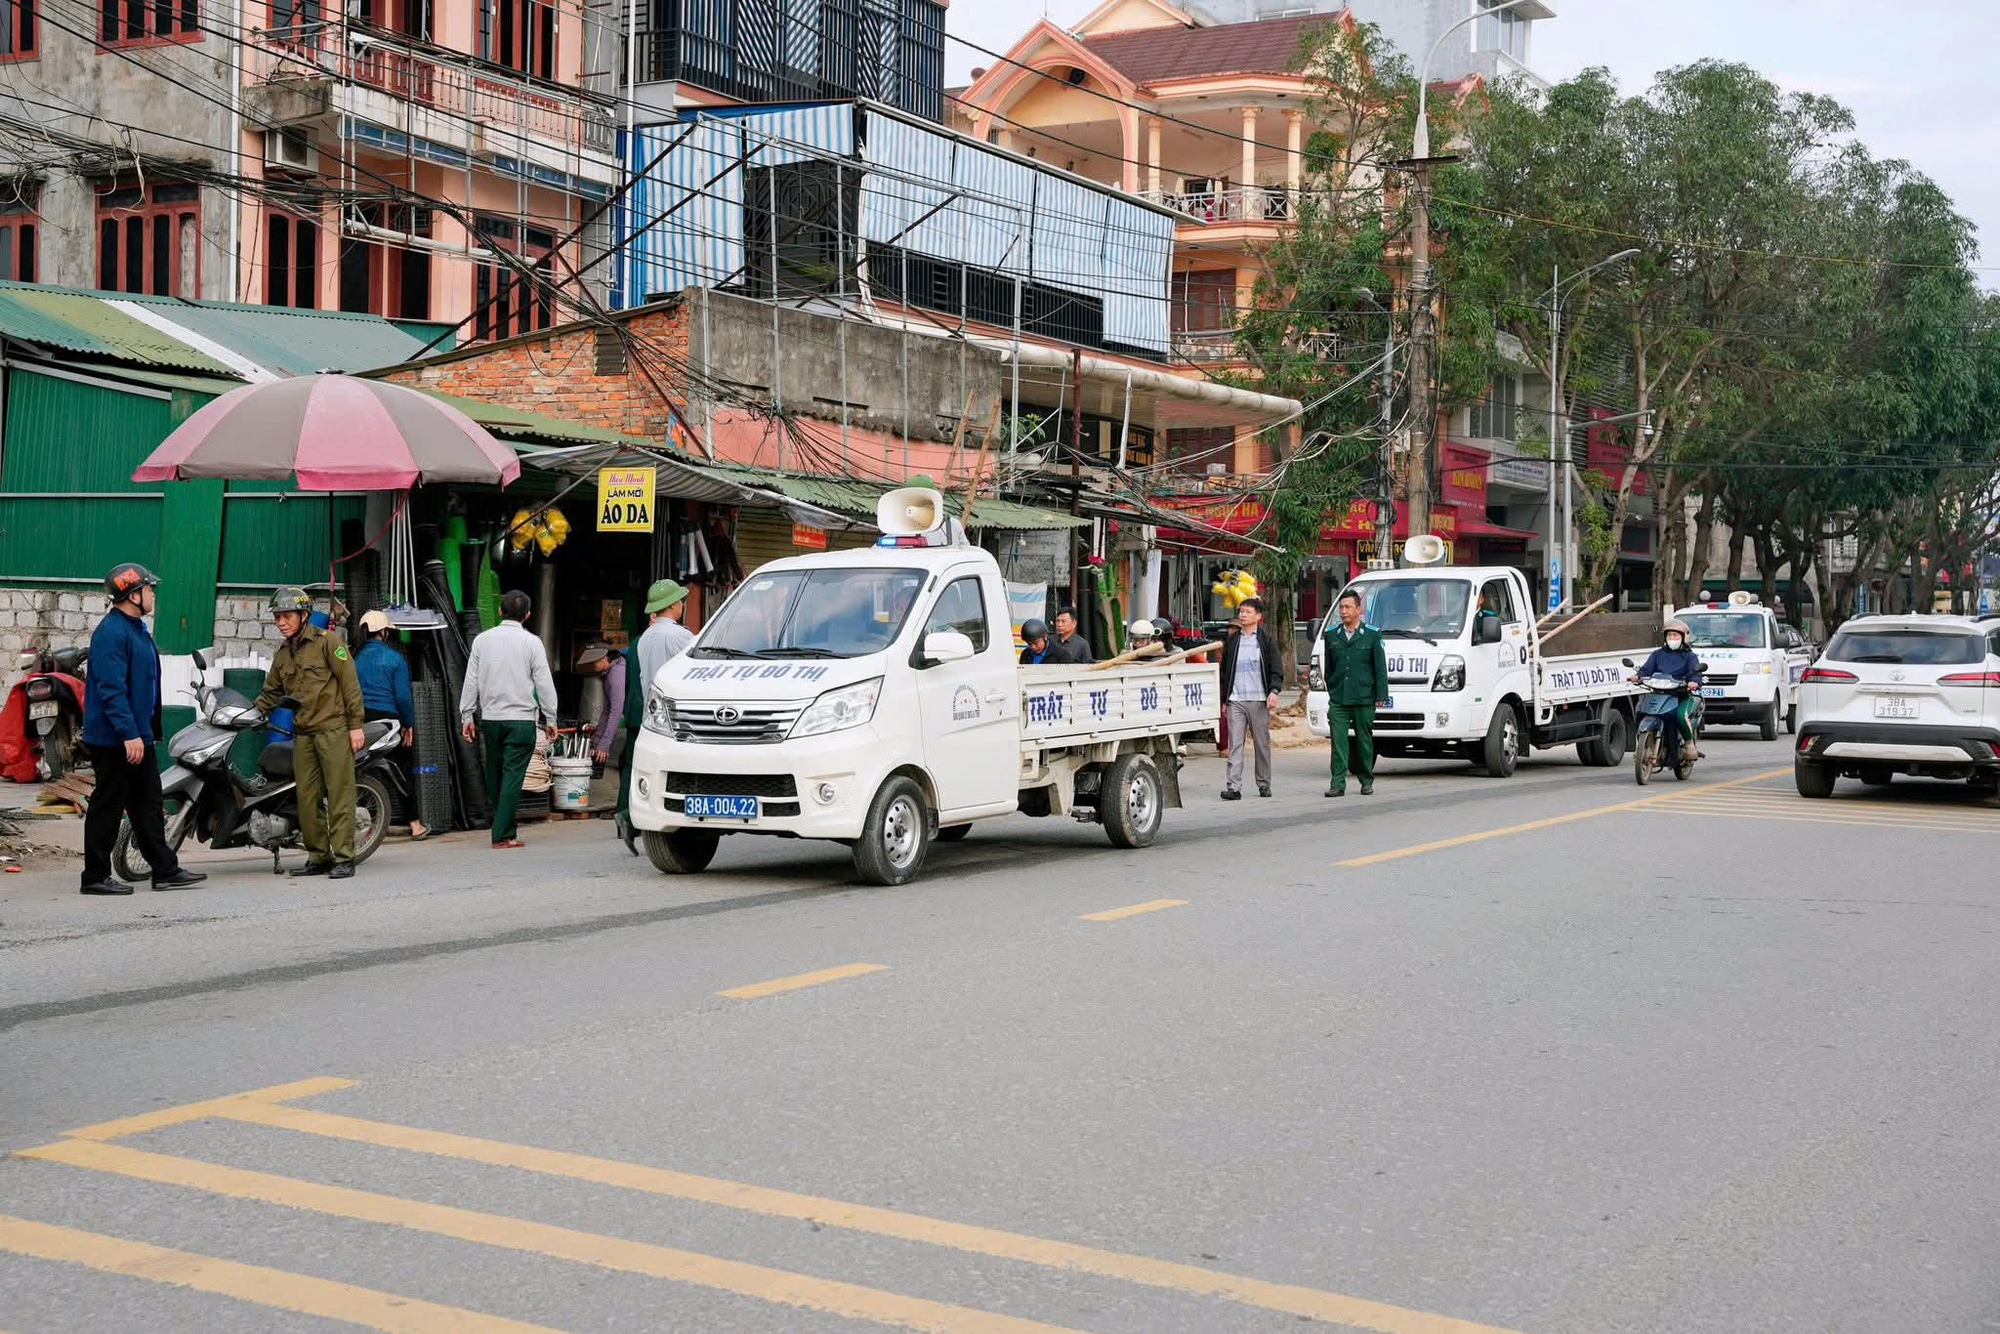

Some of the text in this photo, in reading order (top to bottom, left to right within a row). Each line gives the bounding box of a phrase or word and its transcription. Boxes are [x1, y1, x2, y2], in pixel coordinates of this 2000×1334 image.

[608, 486, 643, 497] LÀM MỚI
[601, 499, 649, 523] ÁO DA
[682, 663, 829, 682] TRẬT TỰ ĐÔ THỊ
[1388, 655, 1428, 675] ĐÔ THỊ
[1551, 665, 1620, 690] TRẬT TỰ ĐÔ THỊ
[1029, 682, 1202, 726] TRẬT TỰ ĐÔ THỊ
[687, 797, 756, 816] 38A-004.22
